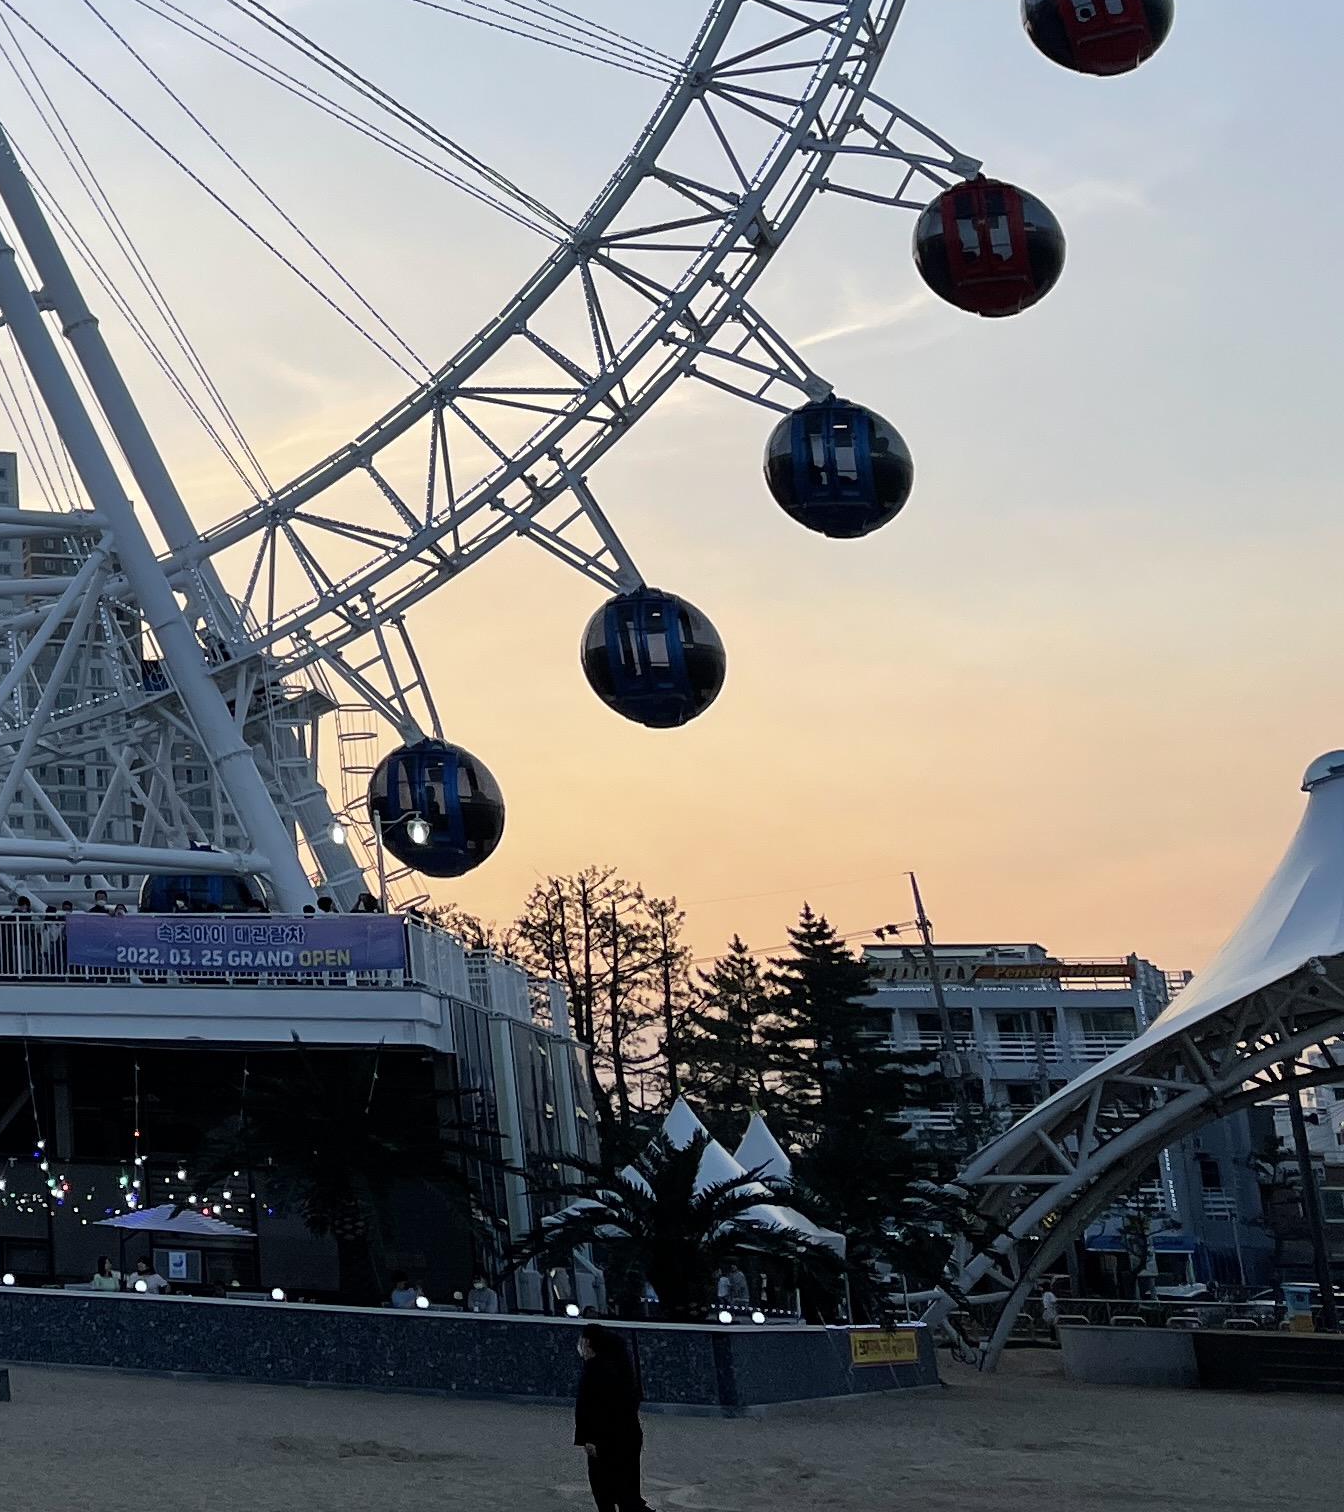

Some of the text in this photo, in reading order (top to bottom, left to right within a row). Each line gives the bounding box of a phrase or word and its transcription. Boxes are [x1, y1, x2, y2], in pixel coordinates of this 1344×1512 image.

[156, 923, 306, 945] 속초아이 대관람차
[116, 946, 352, 967] 2022. 03. 25 GRAND OPEN
